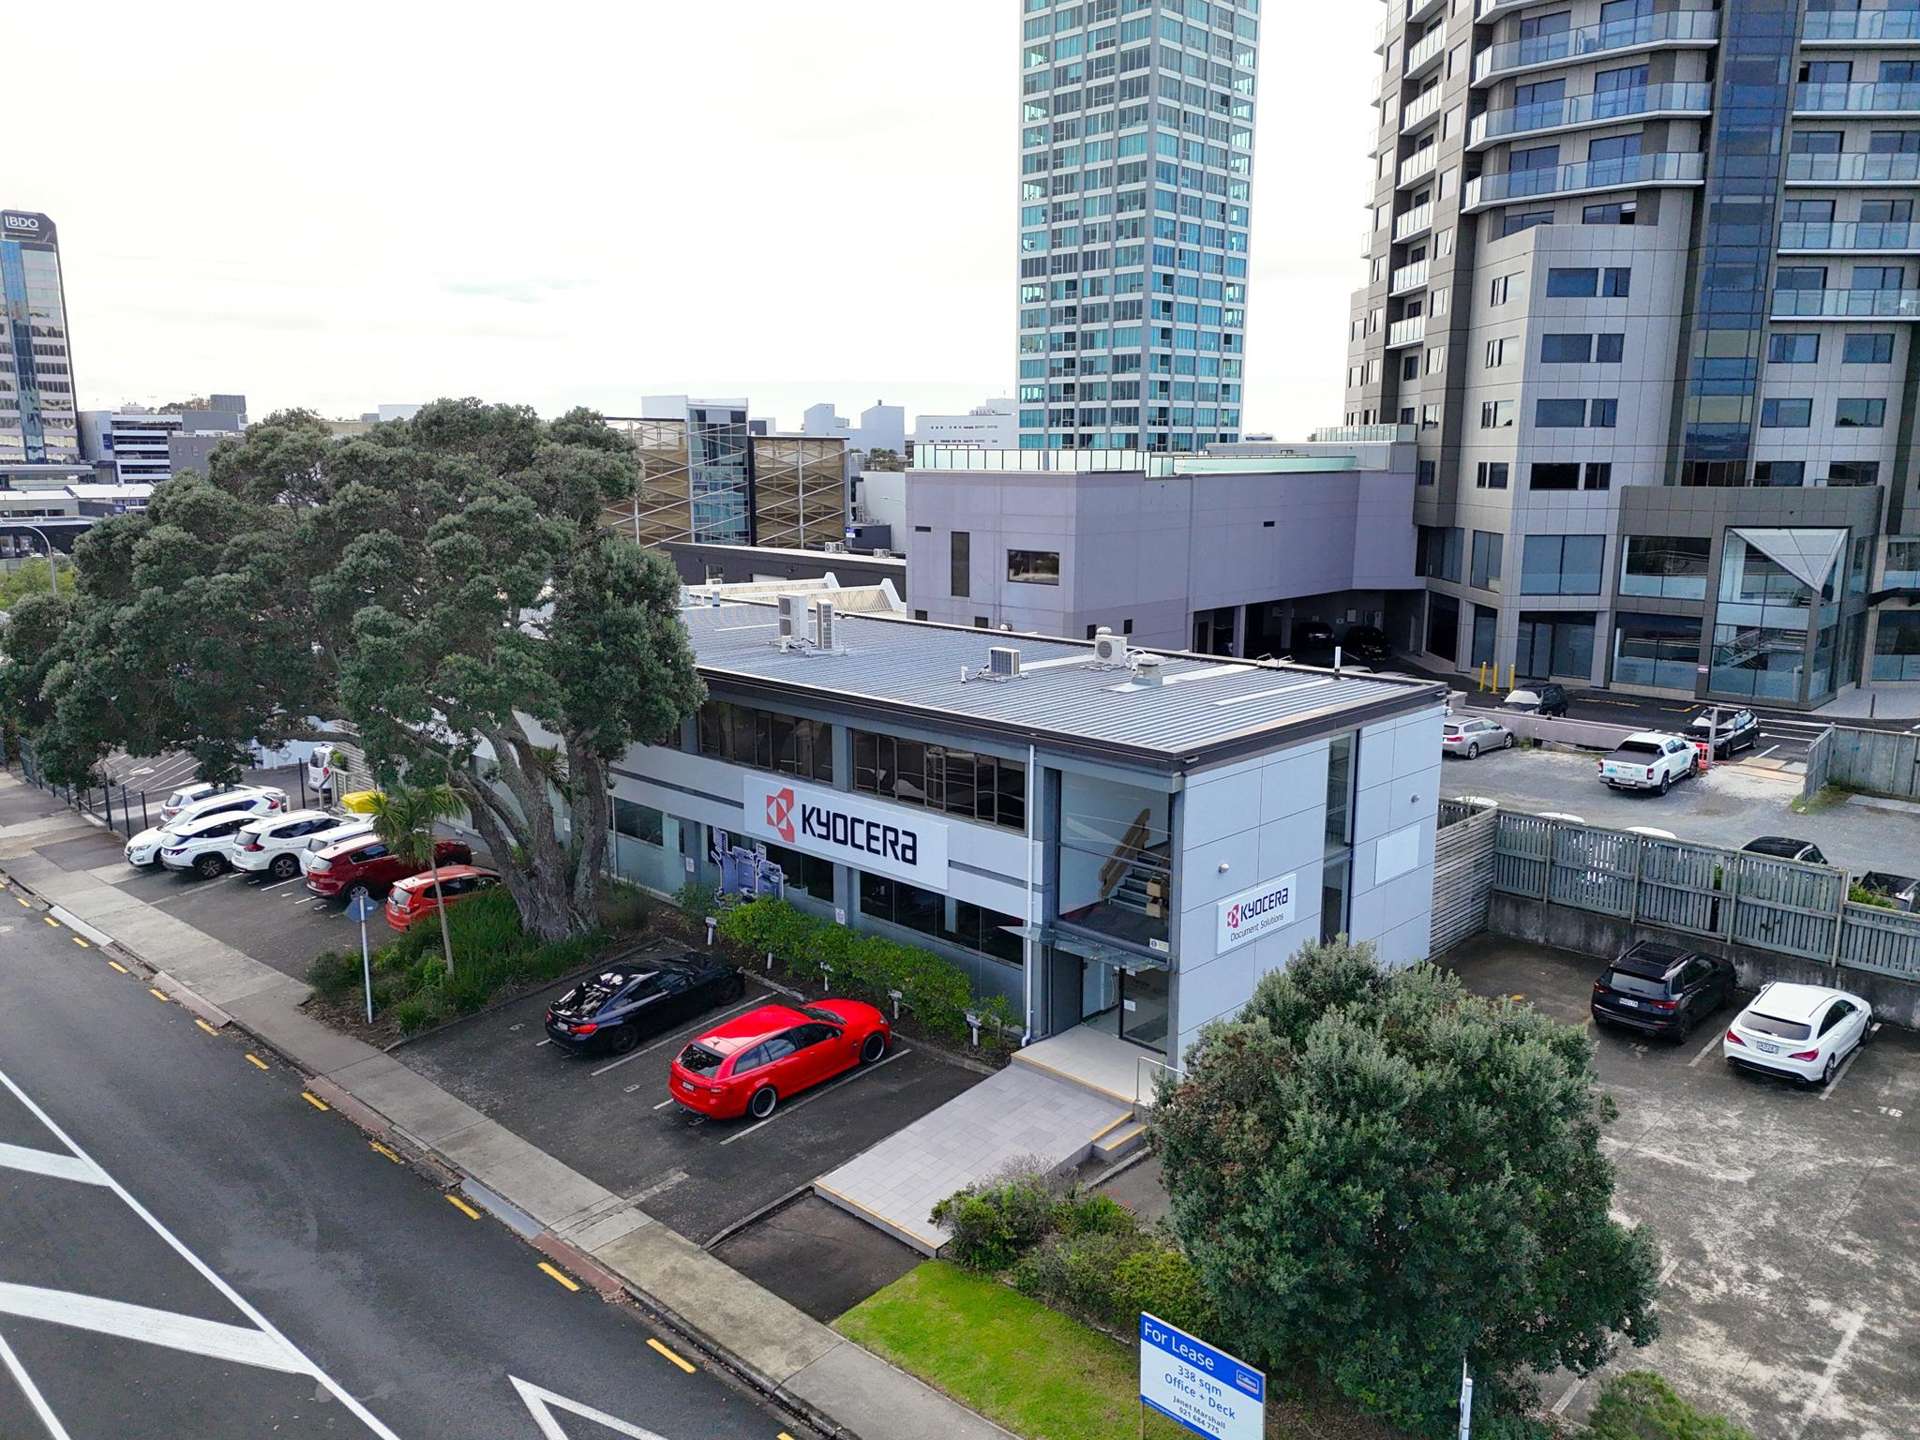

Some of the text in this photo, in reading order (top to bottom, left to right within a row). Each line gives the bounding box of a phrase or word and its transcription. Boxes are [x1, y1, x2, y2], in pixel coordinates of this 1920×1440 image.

[9, 216, 39, 228] BDO
[1230, 912, 1284, 942] Document Solutions
[1144, 1322, 1215, 1371] For Lease
[1164, 1373, 1196, 1397] Office
[1208, 1396, 1236, 1420] Deck
[1177, 1365, 1196, 1383] 338
[1199, 1379, 1222, 1397] sqm
[1193, 1406, 1226, 1429] Marshall
